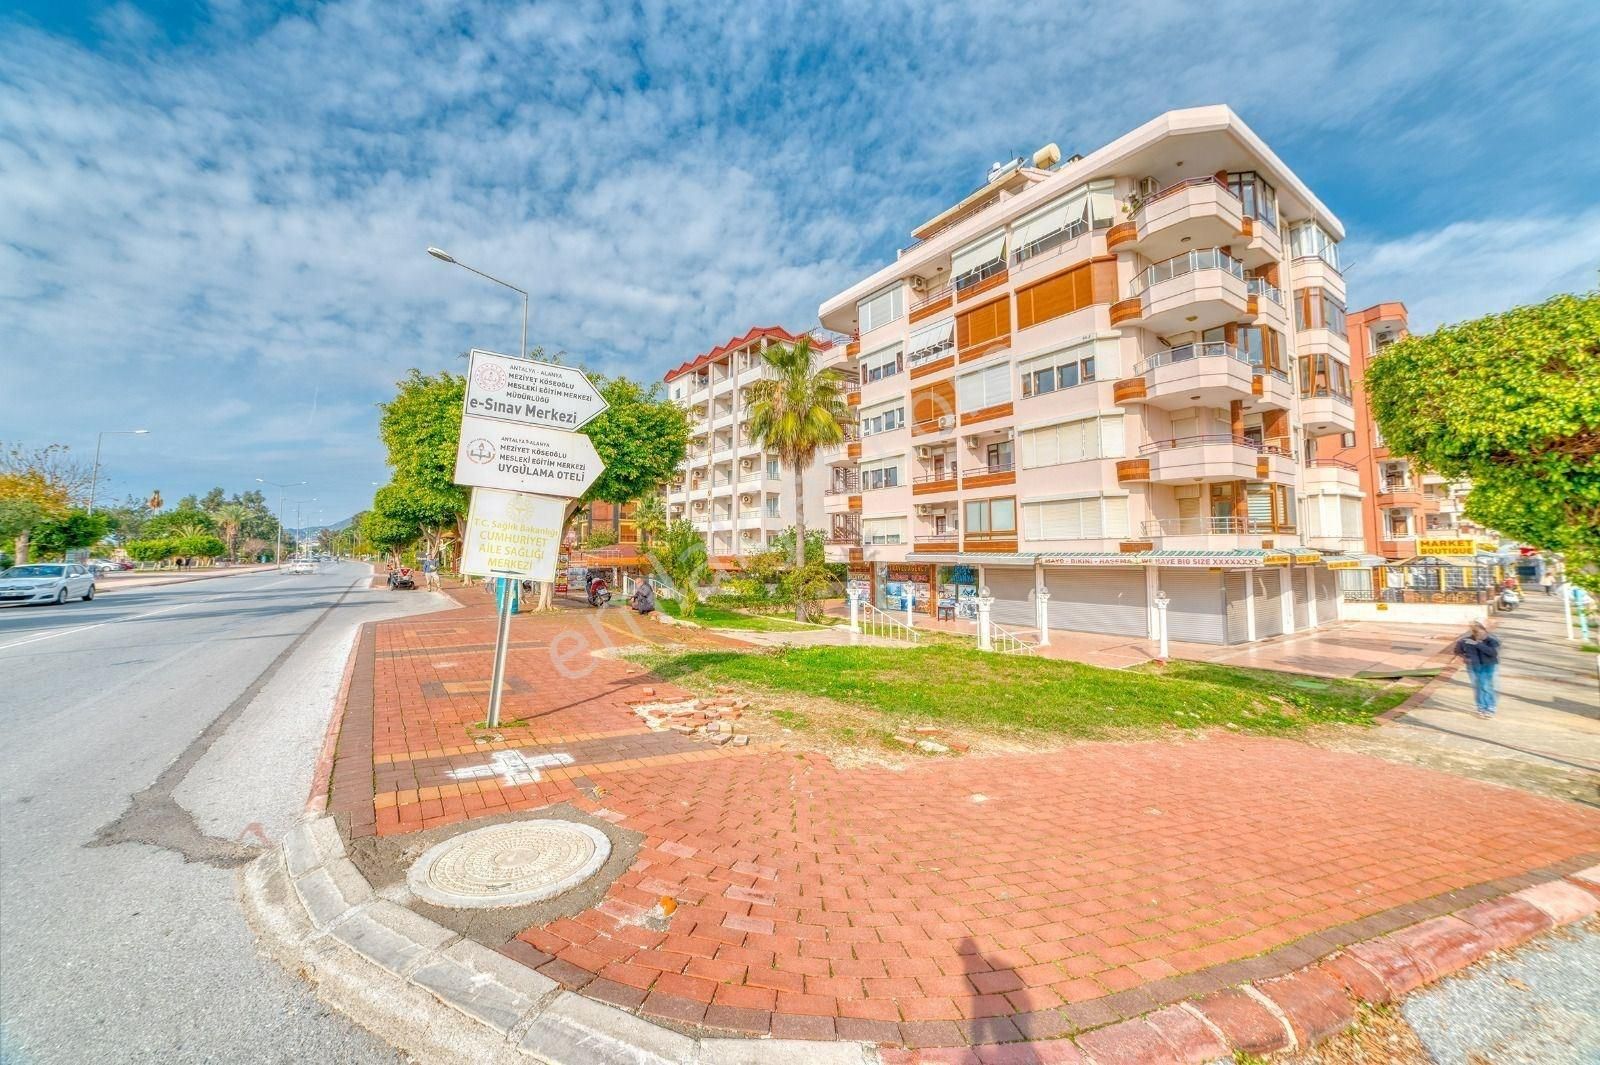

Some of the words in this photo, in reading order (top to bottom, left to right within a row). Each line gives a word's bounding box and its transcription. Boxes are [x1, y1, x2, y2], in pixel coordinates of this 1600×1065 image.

[510, 365, 536, 374] ANTALYA
[541, 371, 563, 379] ALANYA
[508, 373, 538, 383] MEZİYET
[539, 378, 575, 390] KÖSEOĞLU
[506, 391, 550, 404] MÜDÜRLÜĞÜ
[507, 382, 538, 392] MESLEKİ
[539, 387, 562, 397] EĞİTİM
[563, 392, 592, 402] MERKEZİ
[469, 397, 522, 415] e-Sınav
[525, 404, 577, 424] Merkezi
[500, 444, 530, 454] MEZİYET
[531, 447, 567, 459] KÖSEOĞLU
[499, 454, 531, 464] MESLEKİ
[531, 458, 555, 467] EĞİTİM
[556, 461, 586, 471] MERKEZİ
[498, 463, 554, 479] UYGULAMA
[557, 470, 585, 482] OTELİ
[479, 530, 549, 547] CUMHURİYET
[479, 543, 503, 554] AİLE
[504, 545, 545, 560] SAĞLIĞI
[487, 557, 533, 570] MERKEZİ
